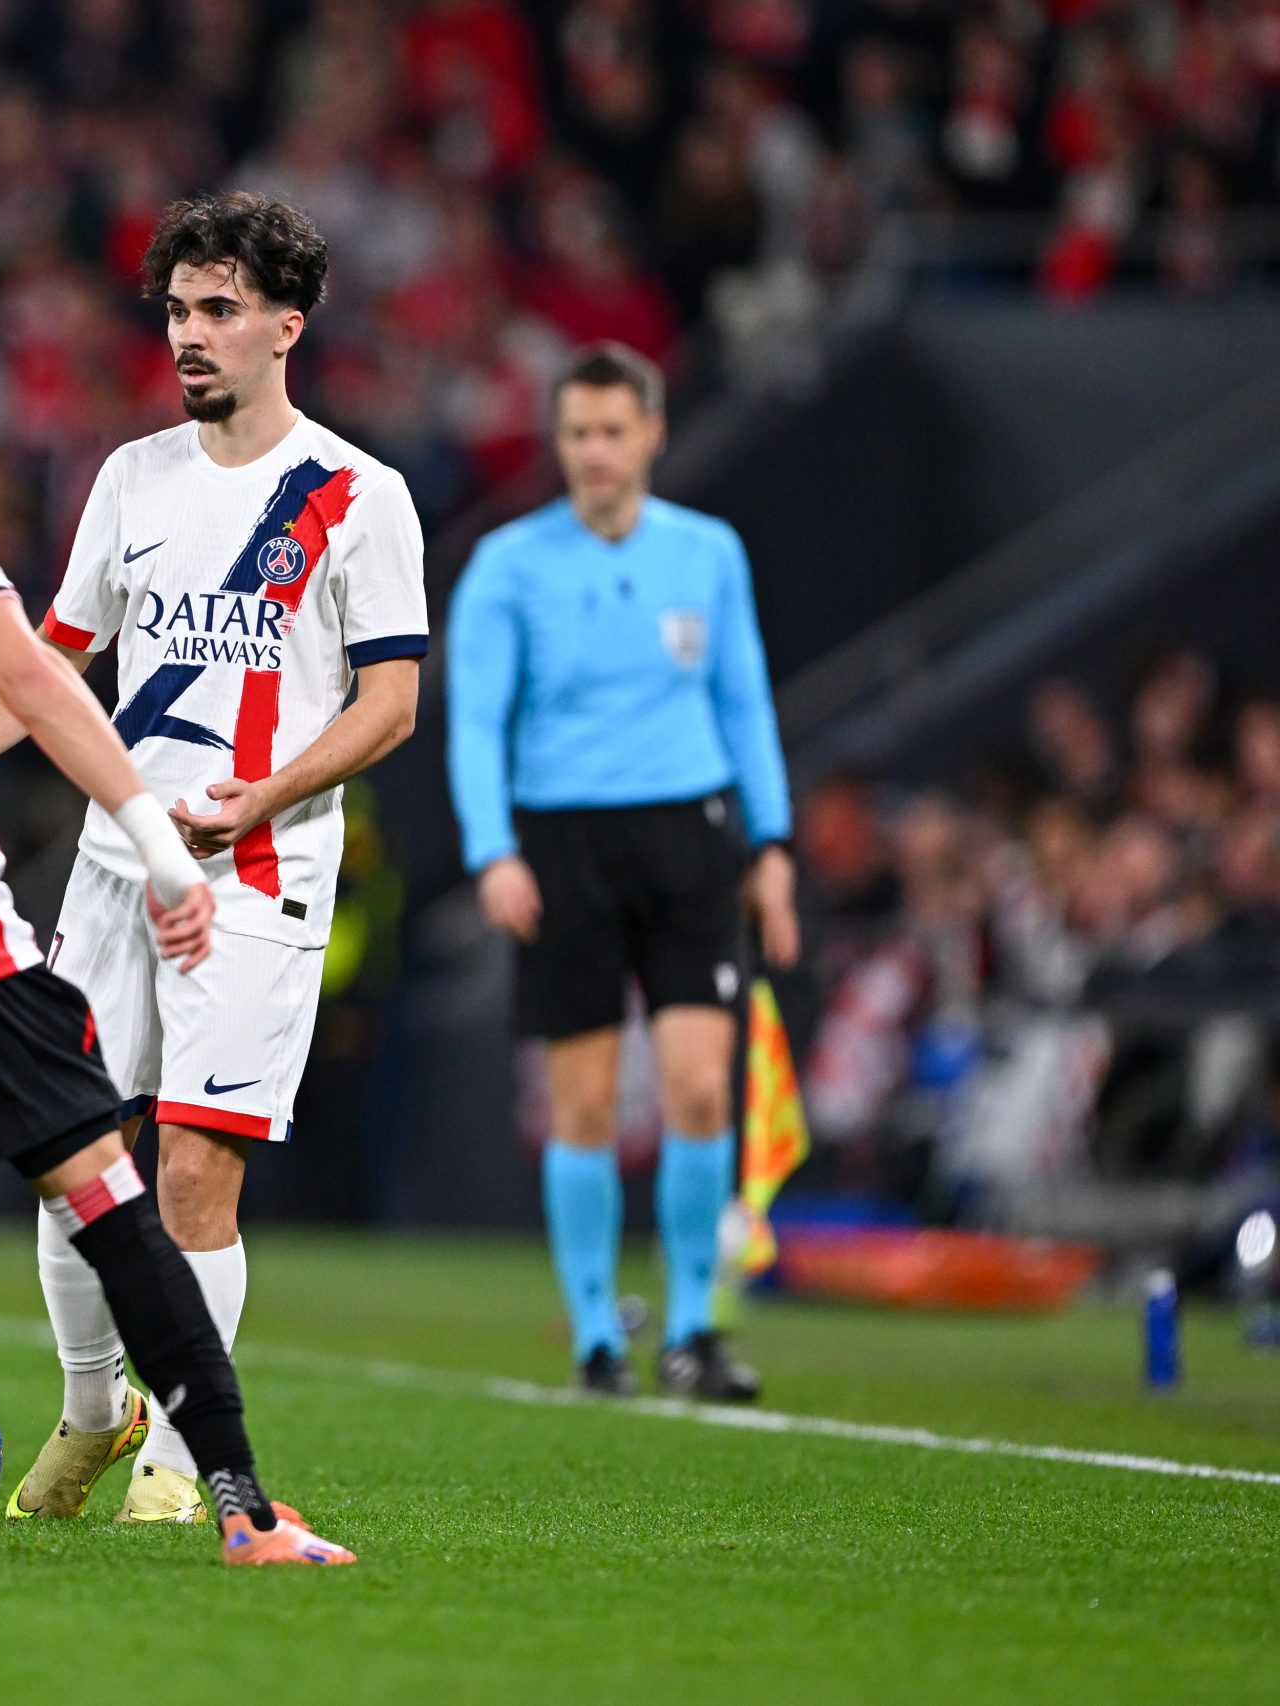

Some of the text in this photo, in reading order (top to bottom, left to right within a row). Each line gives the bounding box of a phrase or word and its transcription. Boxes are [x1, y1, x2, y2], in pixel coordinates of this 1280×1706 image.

[269, 539, 300, 554] PARIS
[136, 590, 283, 640] QATAR
[163, 636, 282, 670] AIRWAYS
